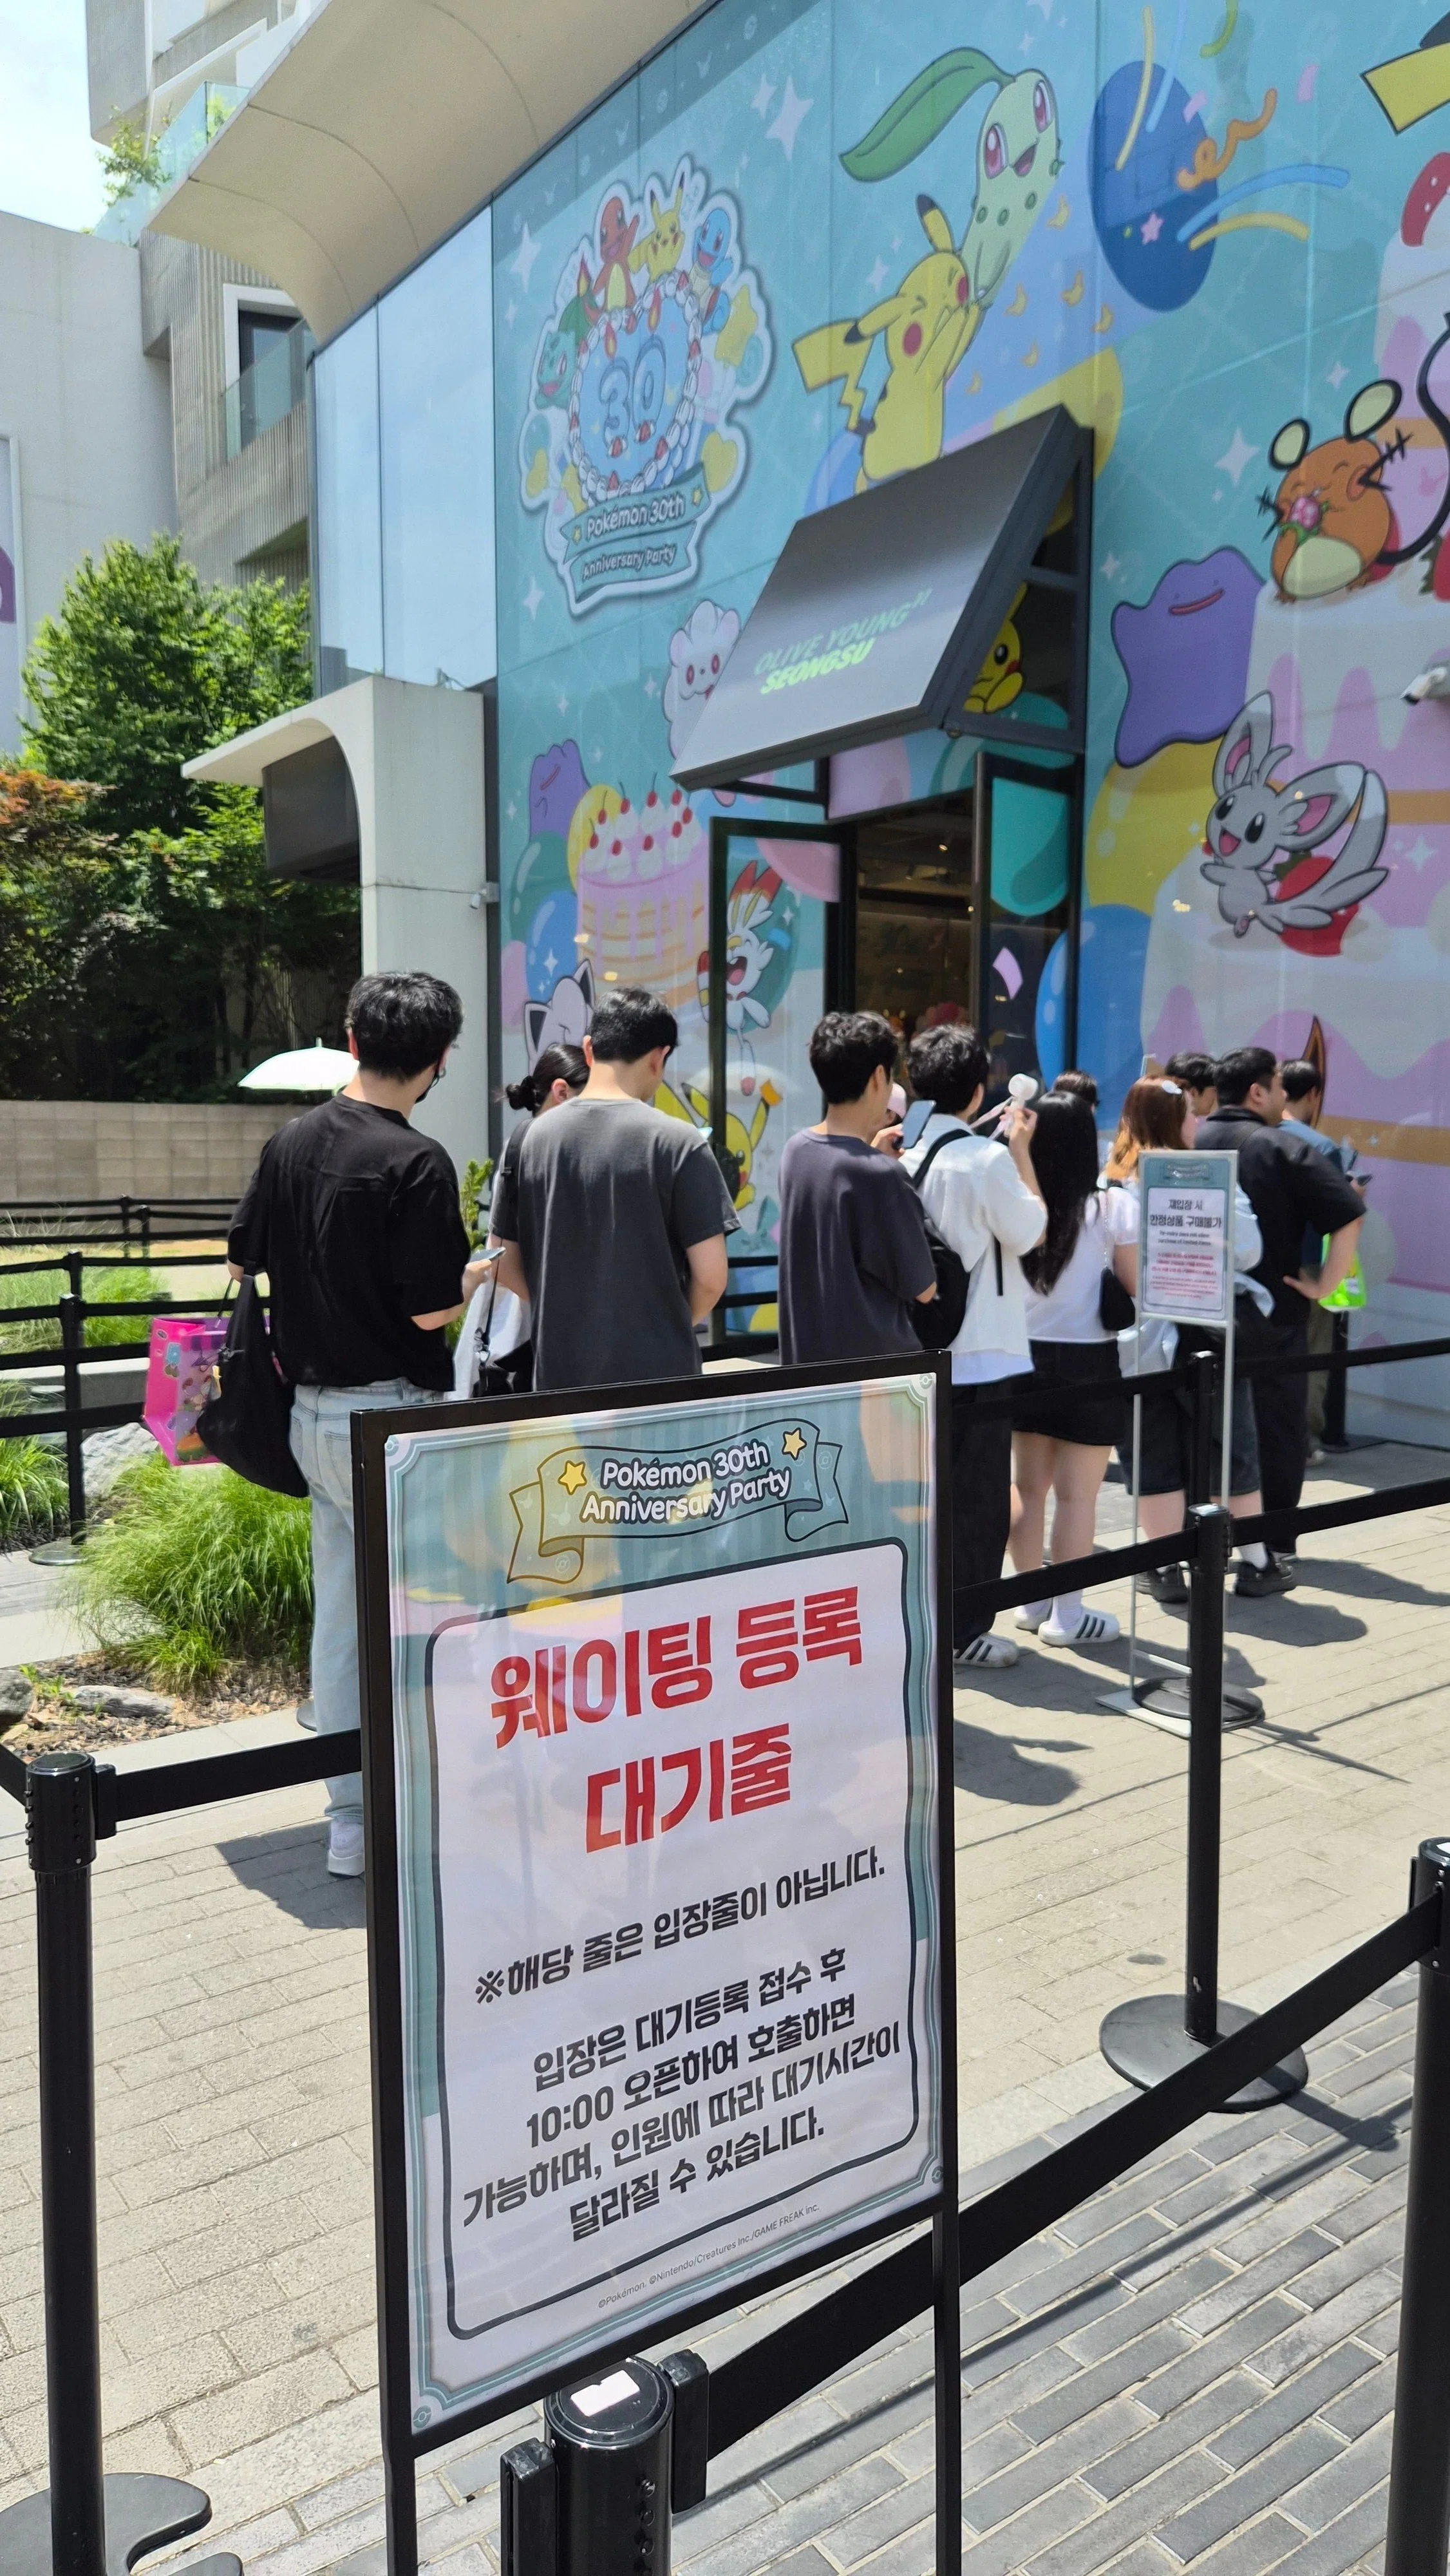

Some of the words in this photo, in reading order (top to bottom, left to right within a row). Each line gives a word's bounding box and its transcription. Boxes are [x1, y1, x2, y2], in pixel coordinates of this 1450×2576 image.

[582, 551, 644, 581] Anniversary
[646, 544, 677, 568] Party
[587, 504, 646, 541] Pokémon
[648, 495, 685, 527] 30th
[753, 634, 824, 676] OLIVE
[826, 603, 912, 651] YOUNG
[760, 637, 876, 696] SEONGSU
[582, 1490, 726, 1520] Anniversary
[730, 1469, 791, 1506] Party
[602, 1457, 712, 1487] Pokémon
[713, 1441, 769, 1477] 30th
[490, 1615, 713, 1749] 웨이팅
[735, 1586, 863, 1689] 등록
[586, 1722, 793, 1853] 대기줄
[583, 1922, 643, 1973] 줄은
[654, 1882, 767, 1949] 입장줄이
[776, 1845, 885, 1909] 아닙니다.
[527, 2086, 614, 2148] 10:00
[623, 2034, 739, 2112] 오픈하여
[748, 1993, 856, 2063] 호출하면
[533, 2024, 627, 2092] 입장은
[636, 1979, 749, 2052] 대기등록
[758, 1960, 812, 2007] 접수
[820, 1947, 846, 1982] 후
[463, 2143, 602, 2228] 가능하며,
[610, 2101, 701, 2166] 인원에
[709, 2076, 765, 2128] 따라
[772, 2021, 901, 2103] 대기시간이
[569, 2168, 661, 2242] 달라질
[670, 2157, 697, 2193] 수
[706, 2106, 825, 2182] 있습니다.
[648, 2240, 737, 2285] ©Nintendo/Creatures
[737, 2221, 778, 2246] Inc./GAME
[778, 2208, 805, 2226] FREAK
[805, 2204, 820, 2215] inc.
